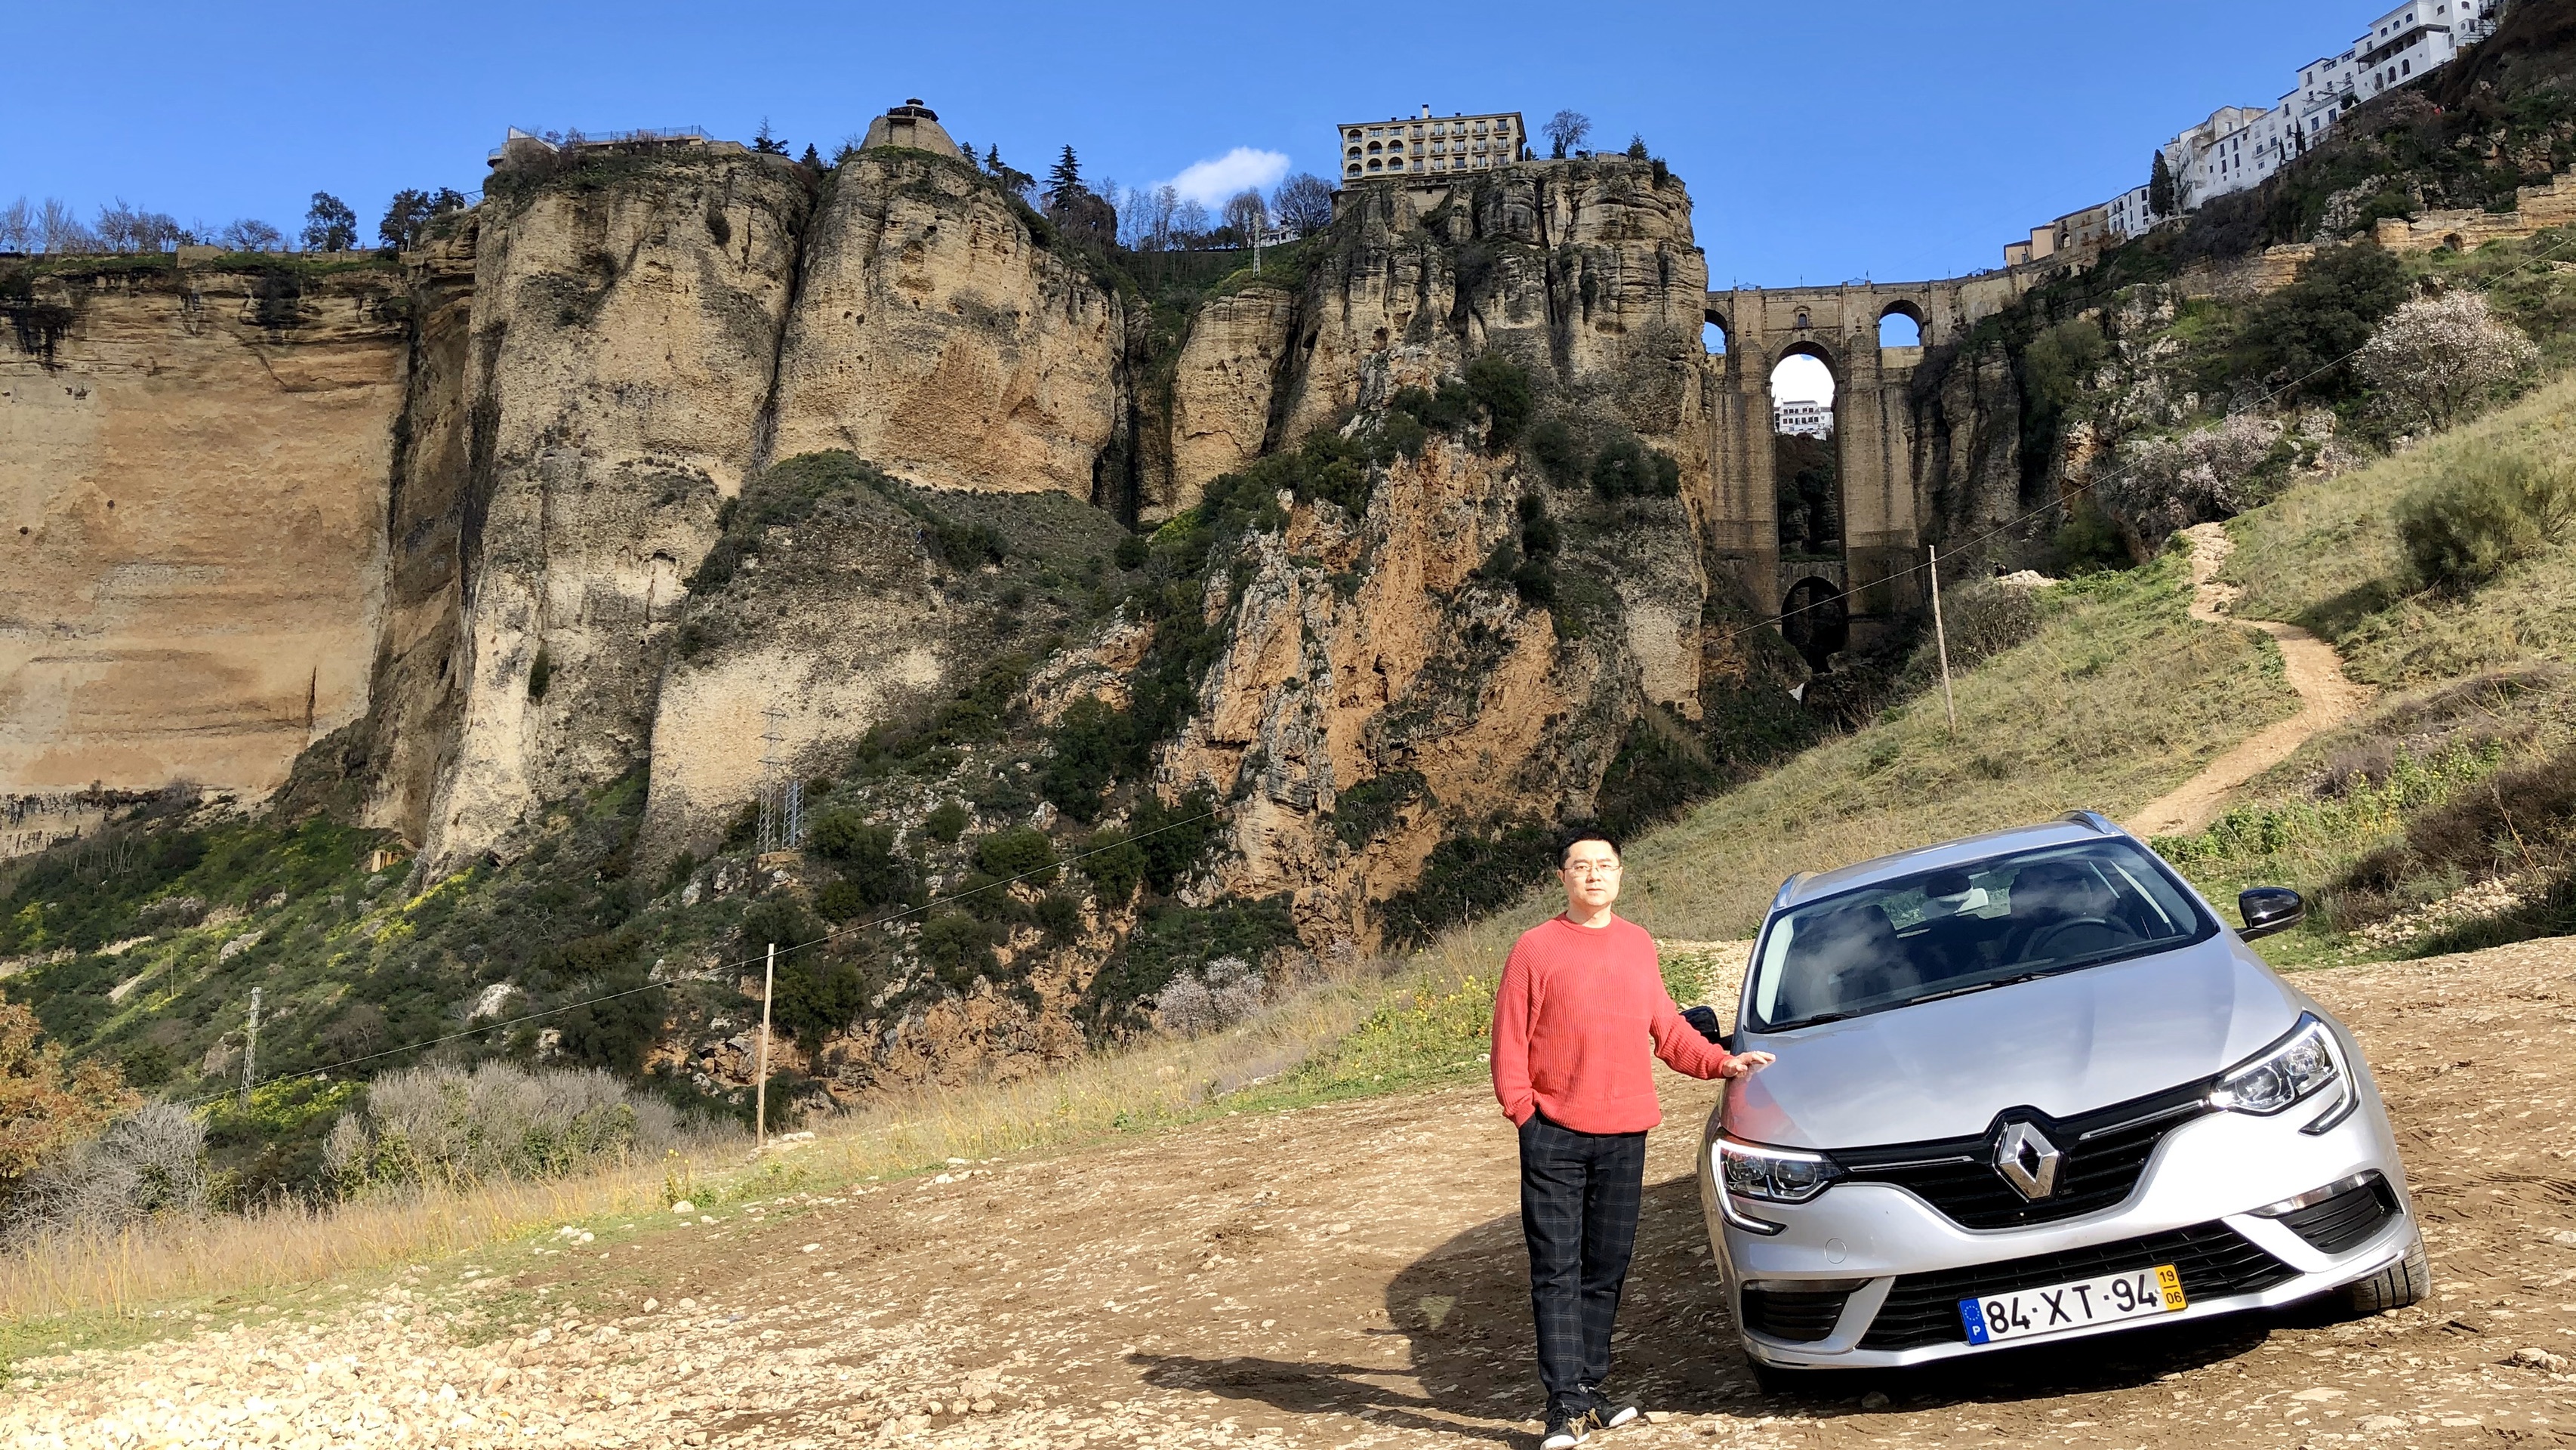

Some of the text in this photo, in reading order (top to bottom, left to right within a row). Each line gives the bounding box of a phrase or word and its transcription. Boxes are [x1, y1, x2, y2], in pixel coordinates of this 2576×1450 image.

[2158, 1270, 2175, 1283] 19
[2165, 1291, 2183, 1305] 06
[1972, 1325, 1980, 1336] P
